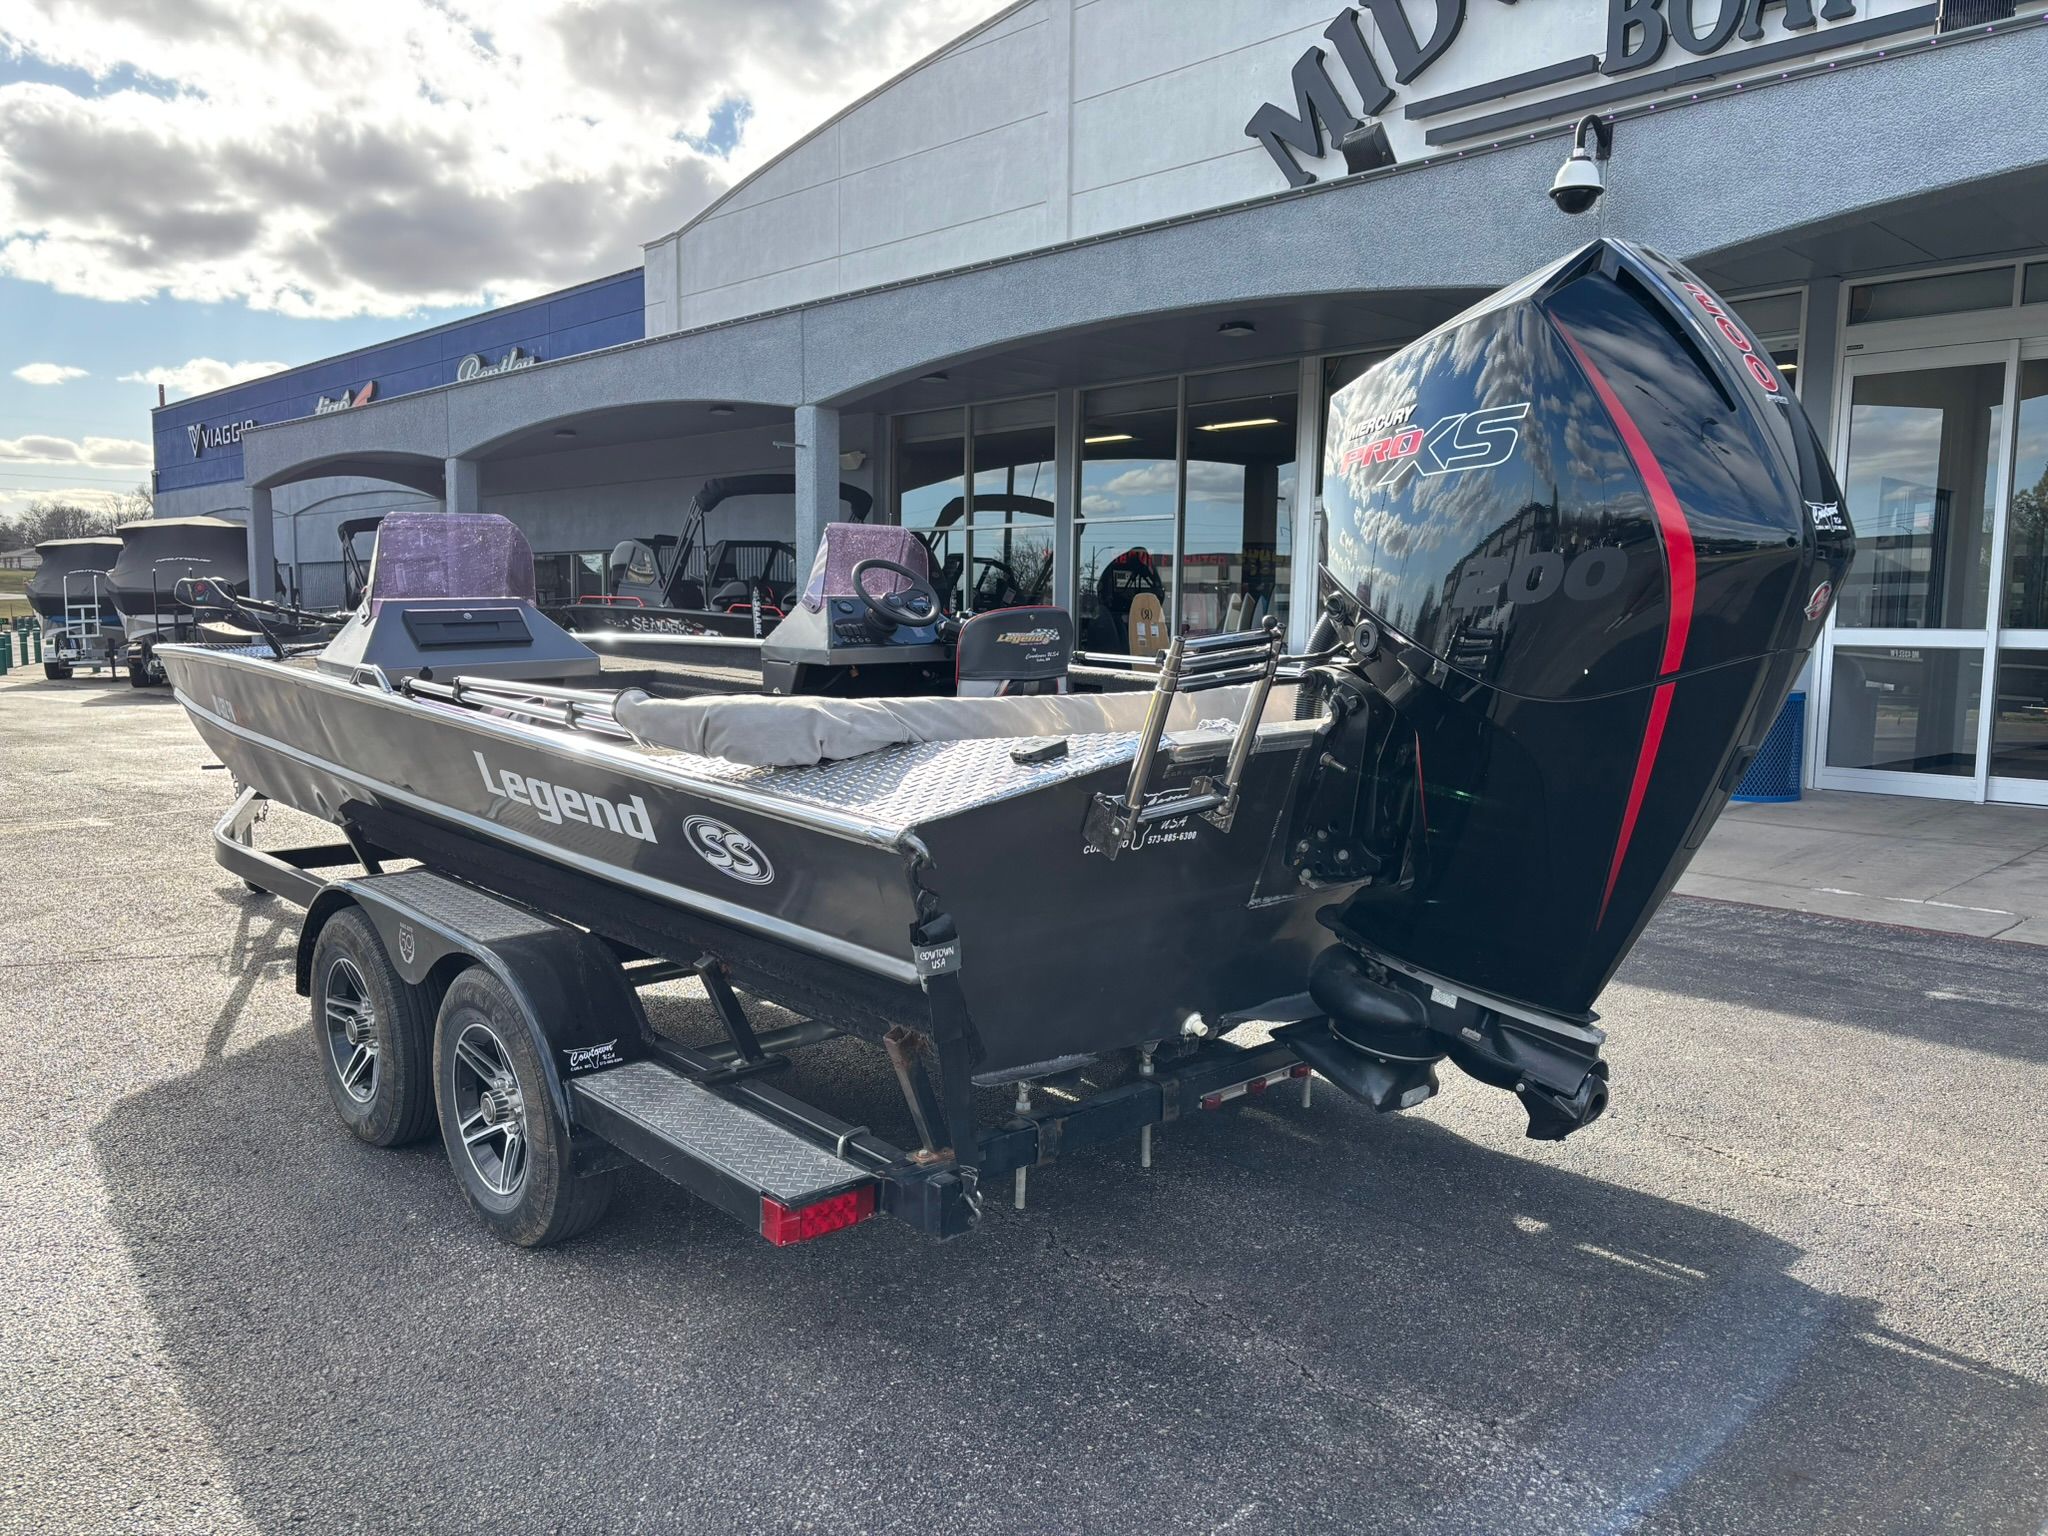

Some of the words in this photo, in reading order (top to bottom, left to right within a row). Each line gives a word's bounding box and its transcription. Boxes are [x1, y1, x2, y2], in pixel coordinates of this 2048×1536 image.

[1600, 0, 1855, 76] BO
[1245, 0, 1517, 188] MID
[1349, 404, 1417, 441] MERCURY
[1376, 402, 1531, 486] XS
[1340, 428, 1425, 476] PRO
[1450, 547, 1629, 608] 200
[473, 750, 658, 844] Legend
[1160, 815, 1189, 830] USA
[697, 823, 761, 878] SS
[1147, 831, 1197, 845] 573-885-6300
[920, 946, 954, 961] COWTOWN
[931, 958, 946, 969] USA
